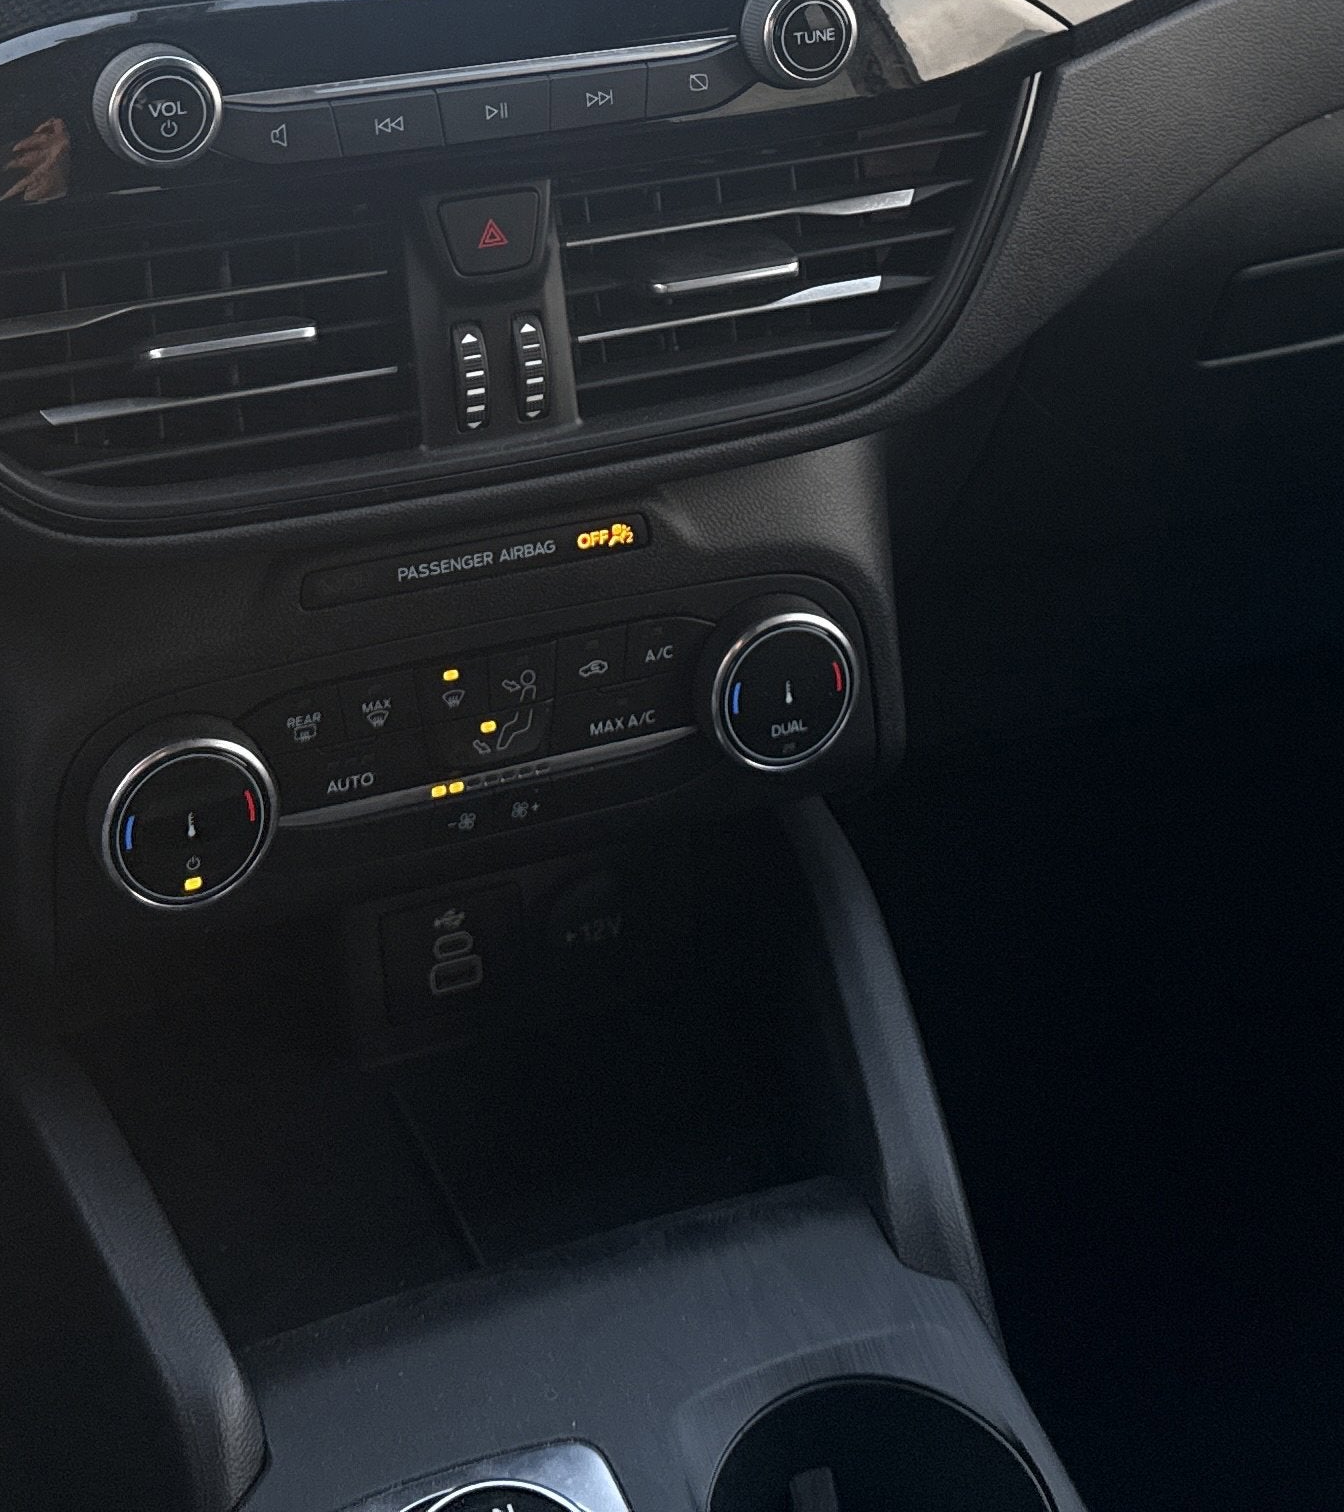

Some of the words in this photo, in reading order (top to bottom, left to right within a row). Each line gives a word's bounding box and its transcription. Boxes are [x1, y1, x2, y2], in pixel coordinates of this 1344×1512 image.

[793, 27, 836, 46] TUNE
[148, 100, 188, 119] VOL
[576, 529, 610, 551] OFF
[397, 552, 494, 582] PASSENGER
[499, 539, 556, 564] AIRBAG
[645, 645, 674, 663] A/C
[361, 697, 392, 713] MAX
[286, 711, 323, 729] REAR
[589, 716, 625, 736] MAX
[628, 709, 656, 728] A/C
[771, 719, 808, 738] DUAL
[326, 771, 375, 794] AUTO
